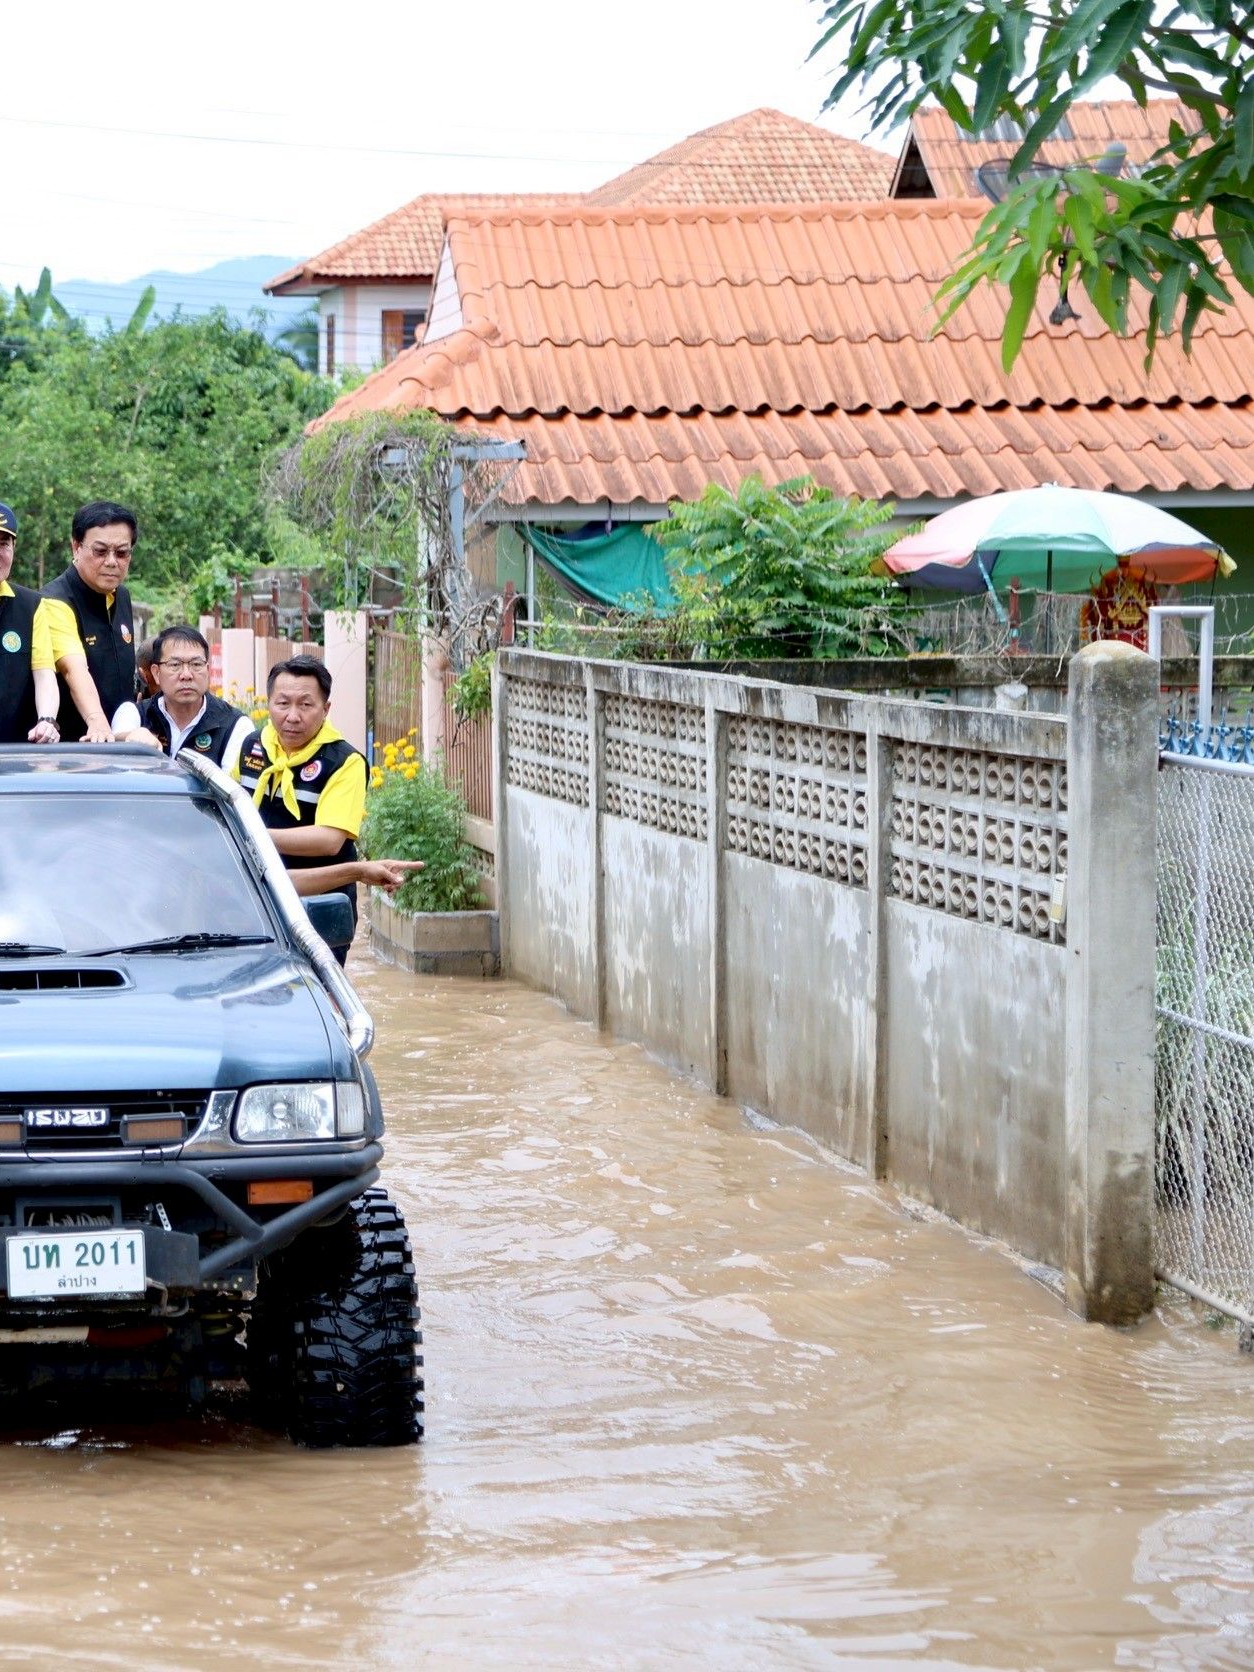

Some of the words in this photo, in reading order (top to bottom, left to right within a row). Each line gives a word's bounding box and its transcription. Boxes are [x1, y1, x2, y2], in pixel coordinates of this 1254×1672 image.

[28, 1109, 107, 1126] ISUZU
[23, 1243, 60, 1270] บท
[75, 1240, 135, 1267] 2011
[57, 1275, 97, 1288] ลำปาง
